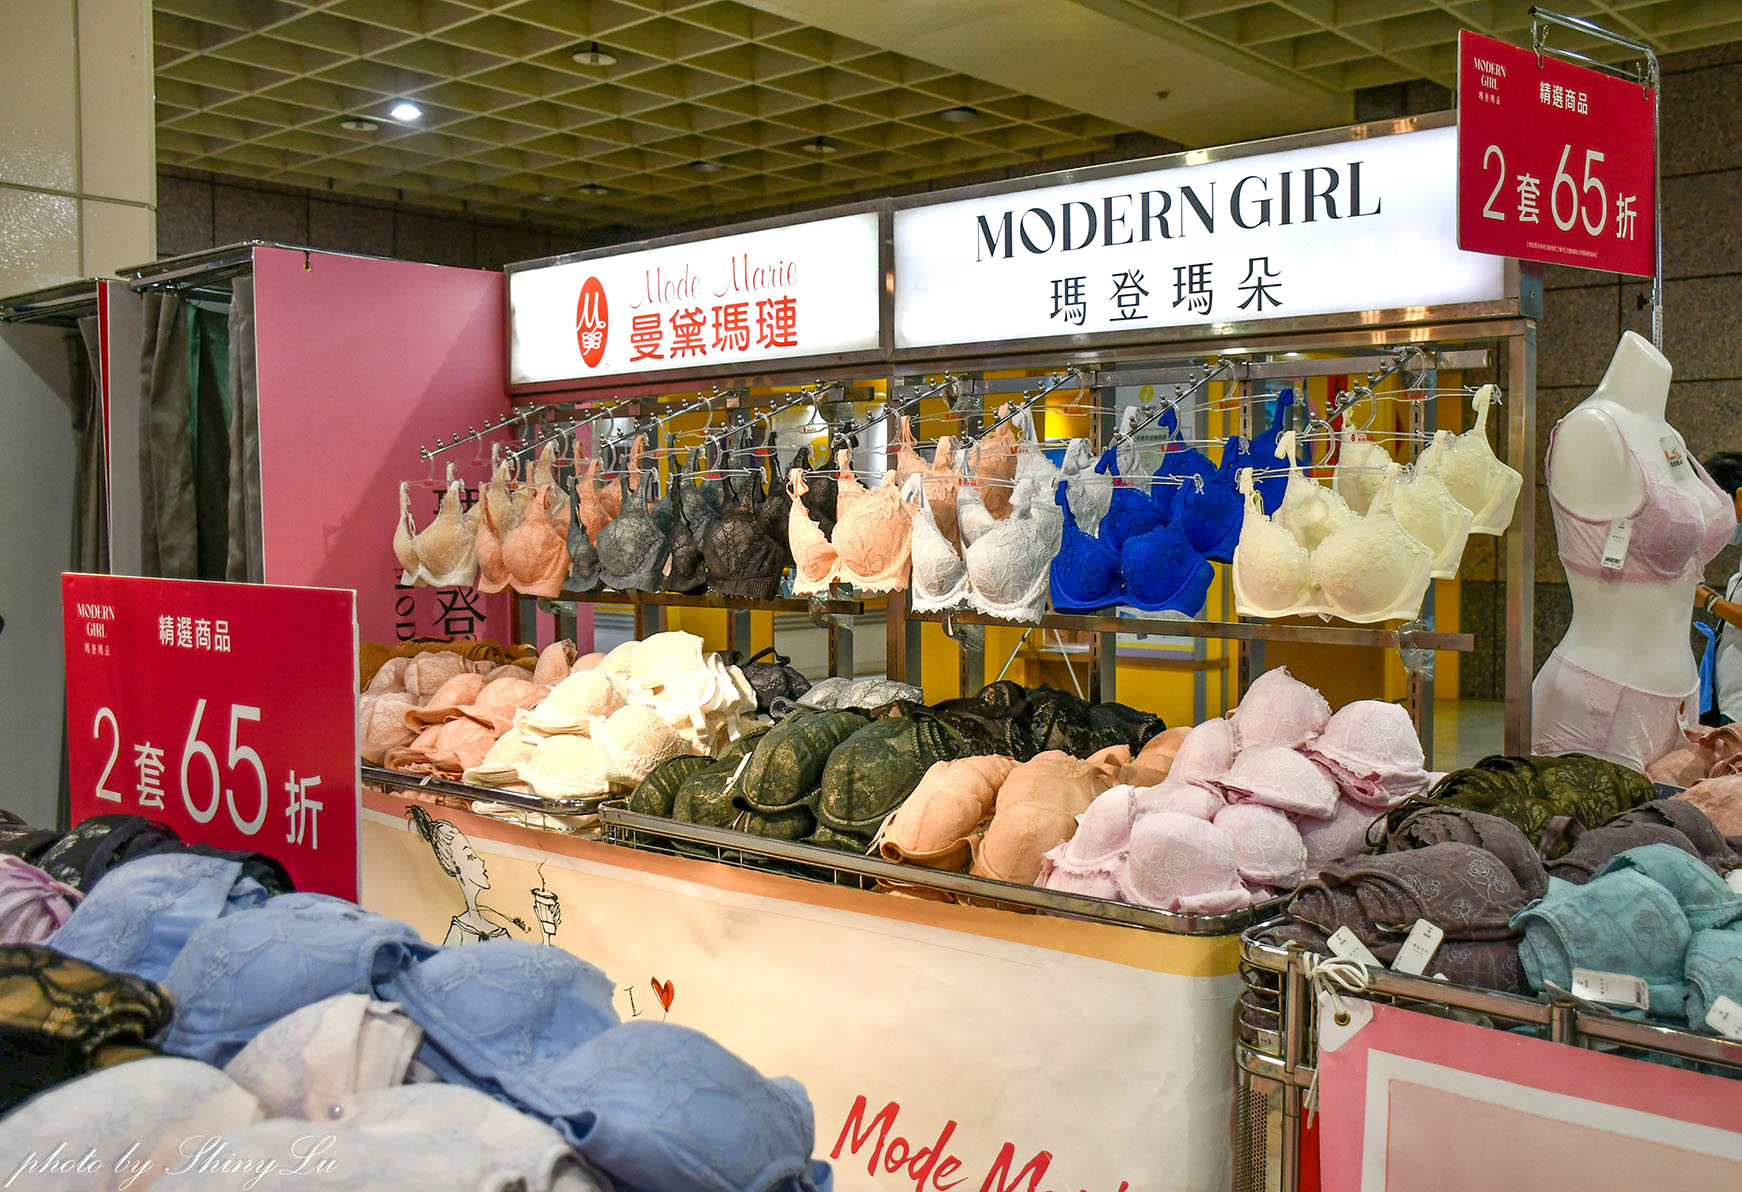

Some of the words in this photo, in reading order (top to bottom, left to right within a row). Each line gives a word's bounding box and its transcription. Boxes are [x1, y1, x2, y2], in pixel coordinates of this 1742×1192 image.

[1473, 57, 1506, 78] MODERN
[1480, 75, 1499, 90] GIRL
[1539, 80, 1588, 115] 精選商品
[976, 182, 1217, 263] MODERN
[1229, 160, 1382, 231] GIRL
[628, 263, 701, 309] Mode
[712, 252, 799, 298] Marie
[1049, 256, 1284, 326] 瑪登瑪朵
[629, 295, 798, 362] 曼黛瑪璉
[77, 603, 116, 621] MODERN
[86, 622, 107, 639] GIRL
[158, 614, 231, 653] 精選商品
[829, 1094, 969, 1192] Mode
